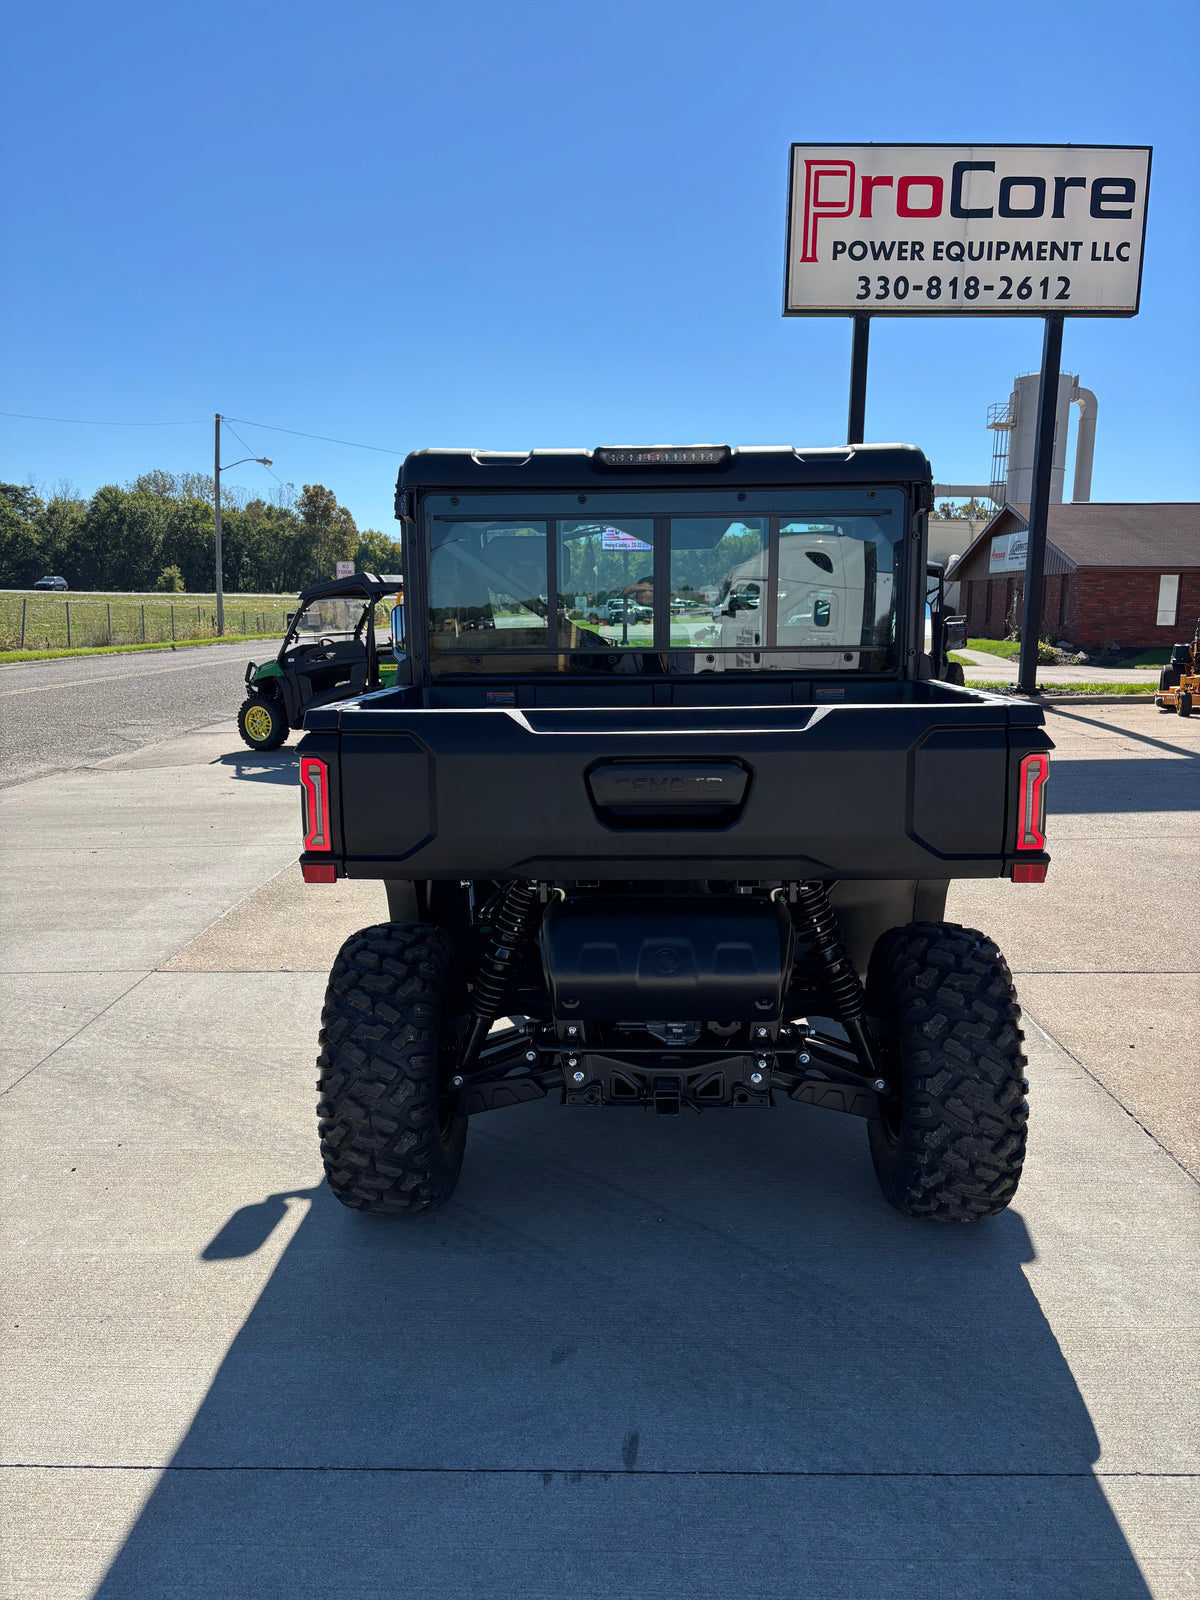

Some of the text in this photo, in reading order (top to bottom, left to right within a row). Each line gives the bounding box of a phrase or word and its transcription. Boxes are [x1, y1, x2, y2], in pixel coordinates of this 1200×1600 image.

[800, 160, 1136, 262] ProCore
[832, 240, 1131, 263] POWER EQUIPMENT LLC
[856, 276, 1071, 300] 330-818-2612
[615, 777, 724, 792] CFMOTO
